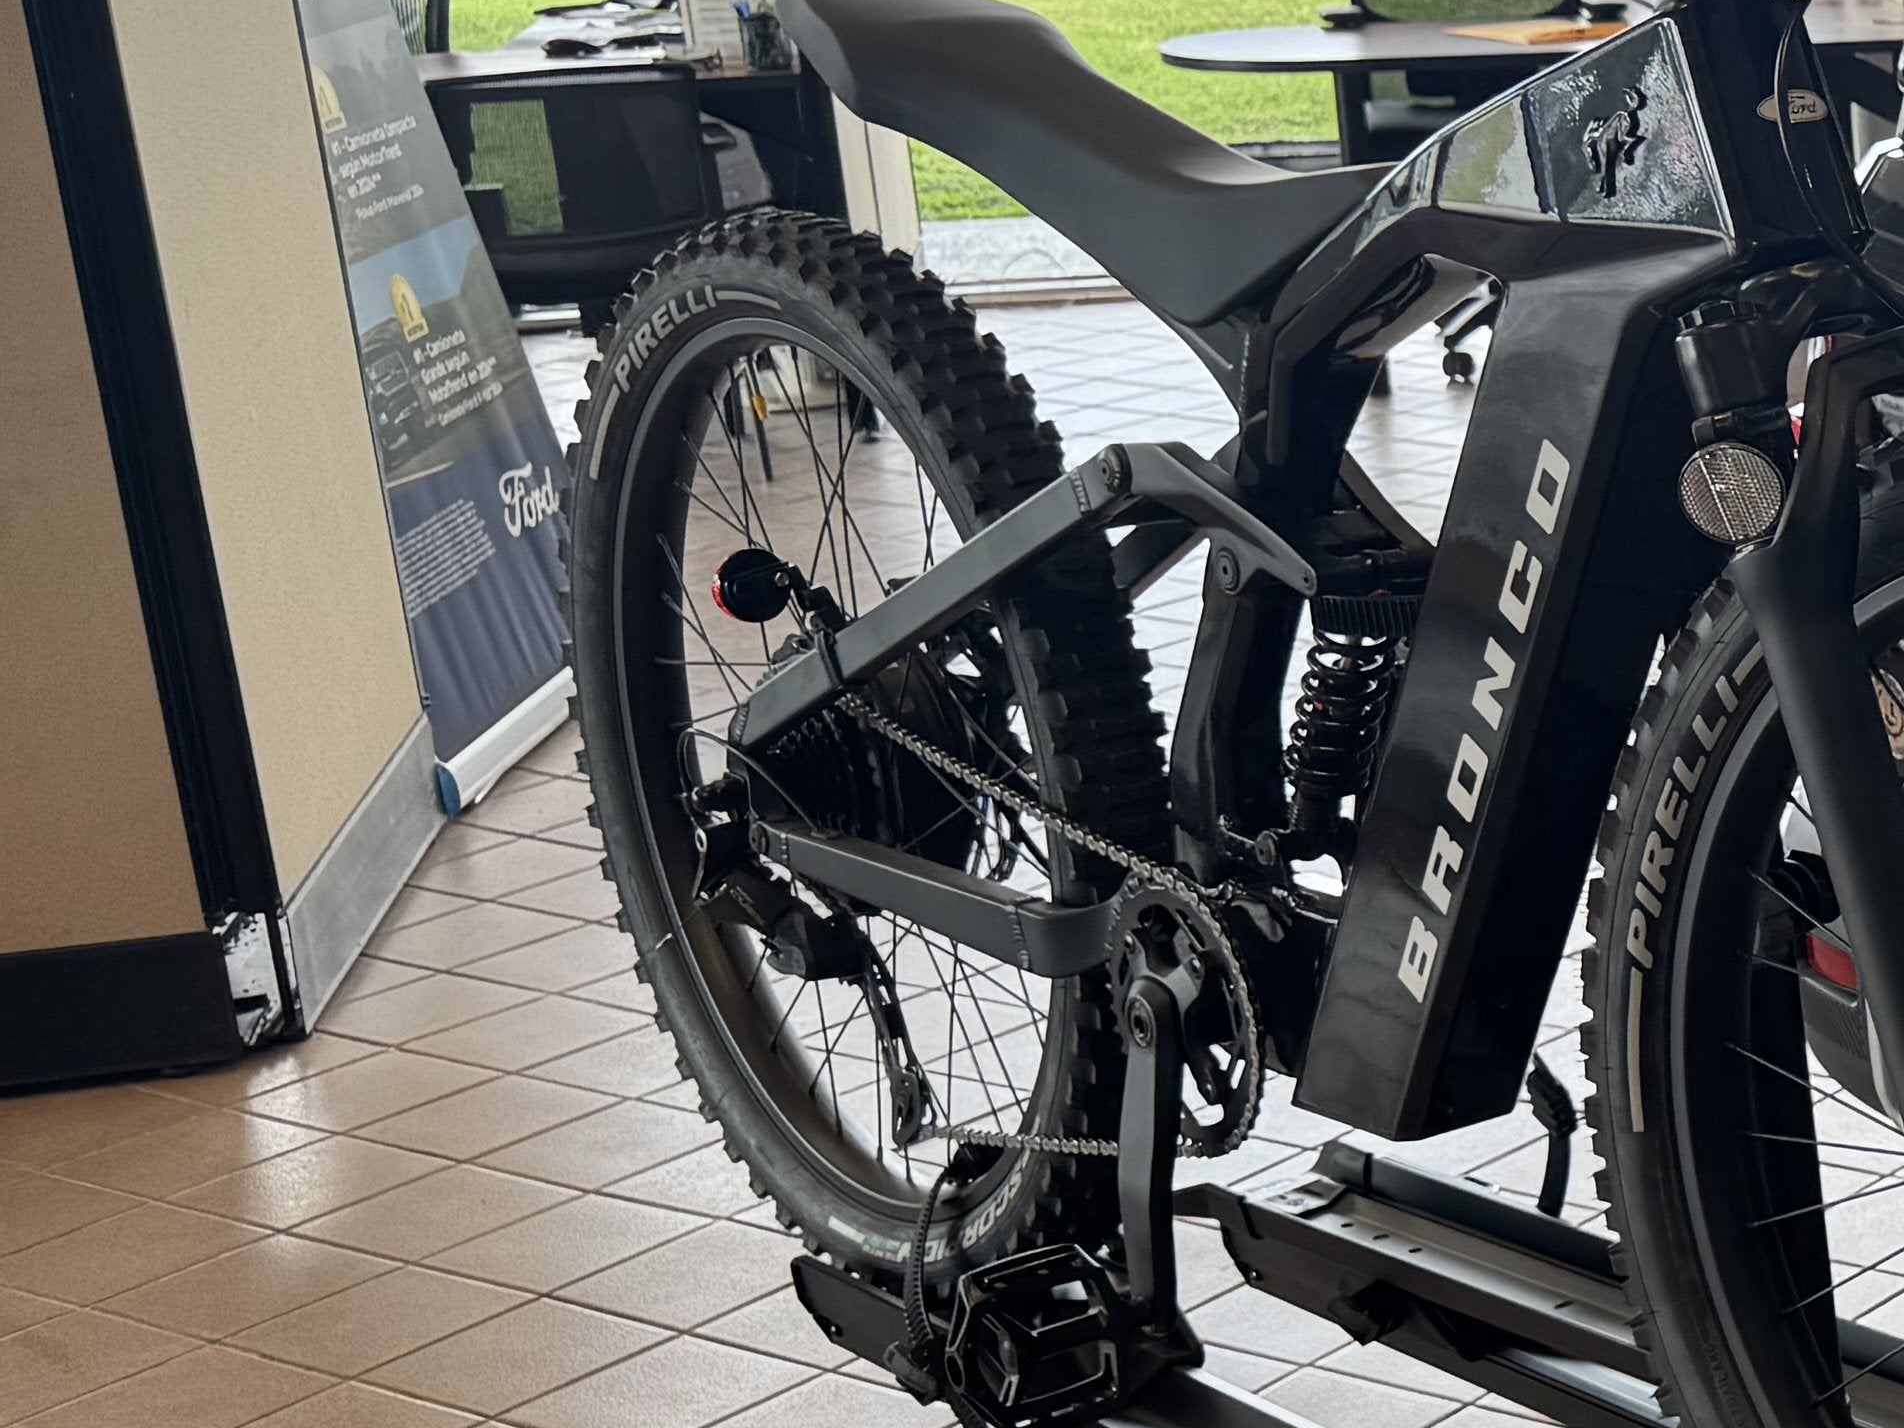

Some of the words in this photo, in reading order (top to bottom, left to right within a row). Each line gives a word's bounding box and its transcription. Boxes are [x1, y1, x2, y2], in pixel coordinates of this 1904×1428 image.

[614, 284, 718, 393] PIRELLI
[498, 461, 560, 538] Ford
[1398, 438, 1571, 1003] BRONCO
[1627, 674, 1745, 971] PIRELLI
